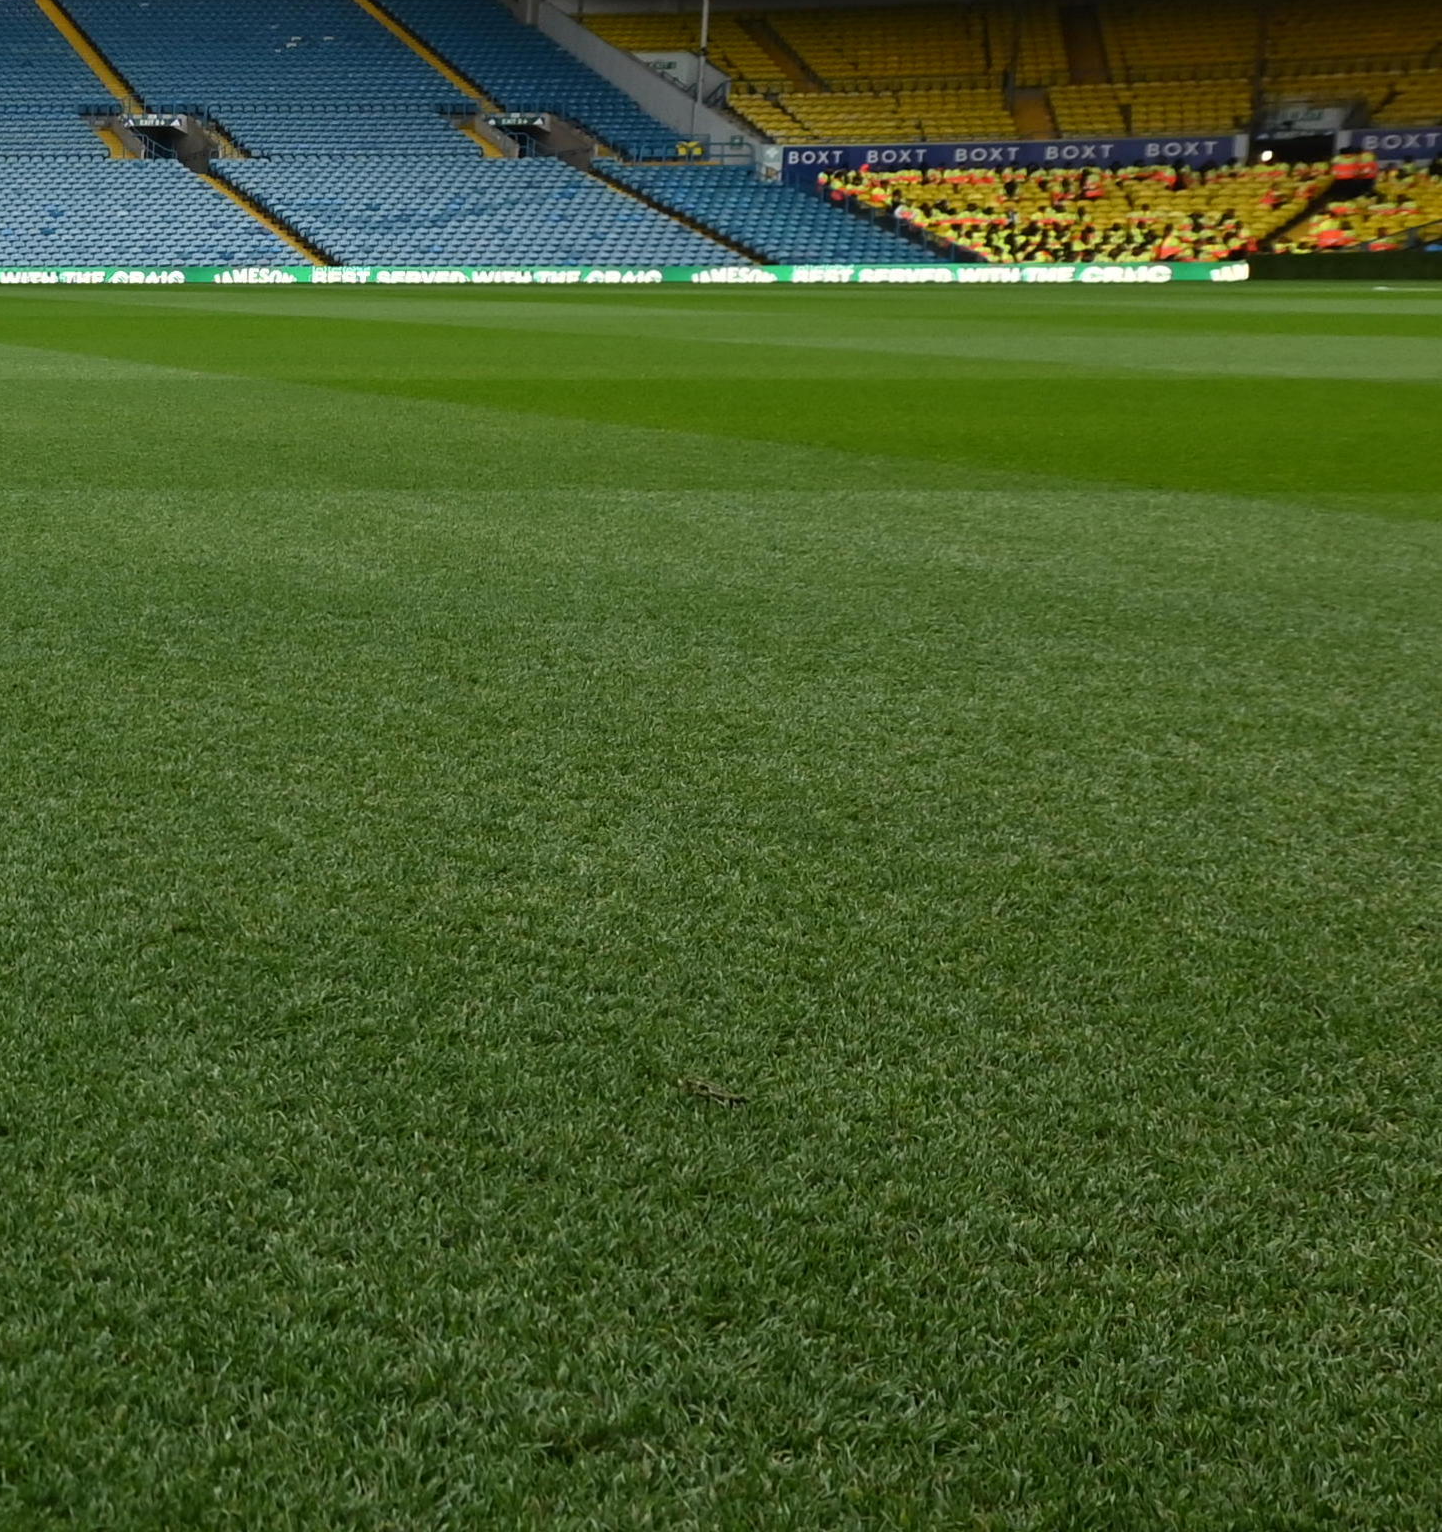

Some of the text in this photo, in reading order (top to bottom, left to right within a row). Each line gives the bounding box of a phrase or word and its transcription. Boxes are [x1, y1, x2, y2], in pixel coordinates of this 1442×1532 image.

[1365, 131, 1442, 149] BOXT
[787, 150, 844, 165] BOXT
[867, 149, 928, 165] BOXT
[955, 146, 1020, 162] BOXT
[1045, 144, 1114, 160] BOXT
[1145, 141, 1219, 158] BOXT
